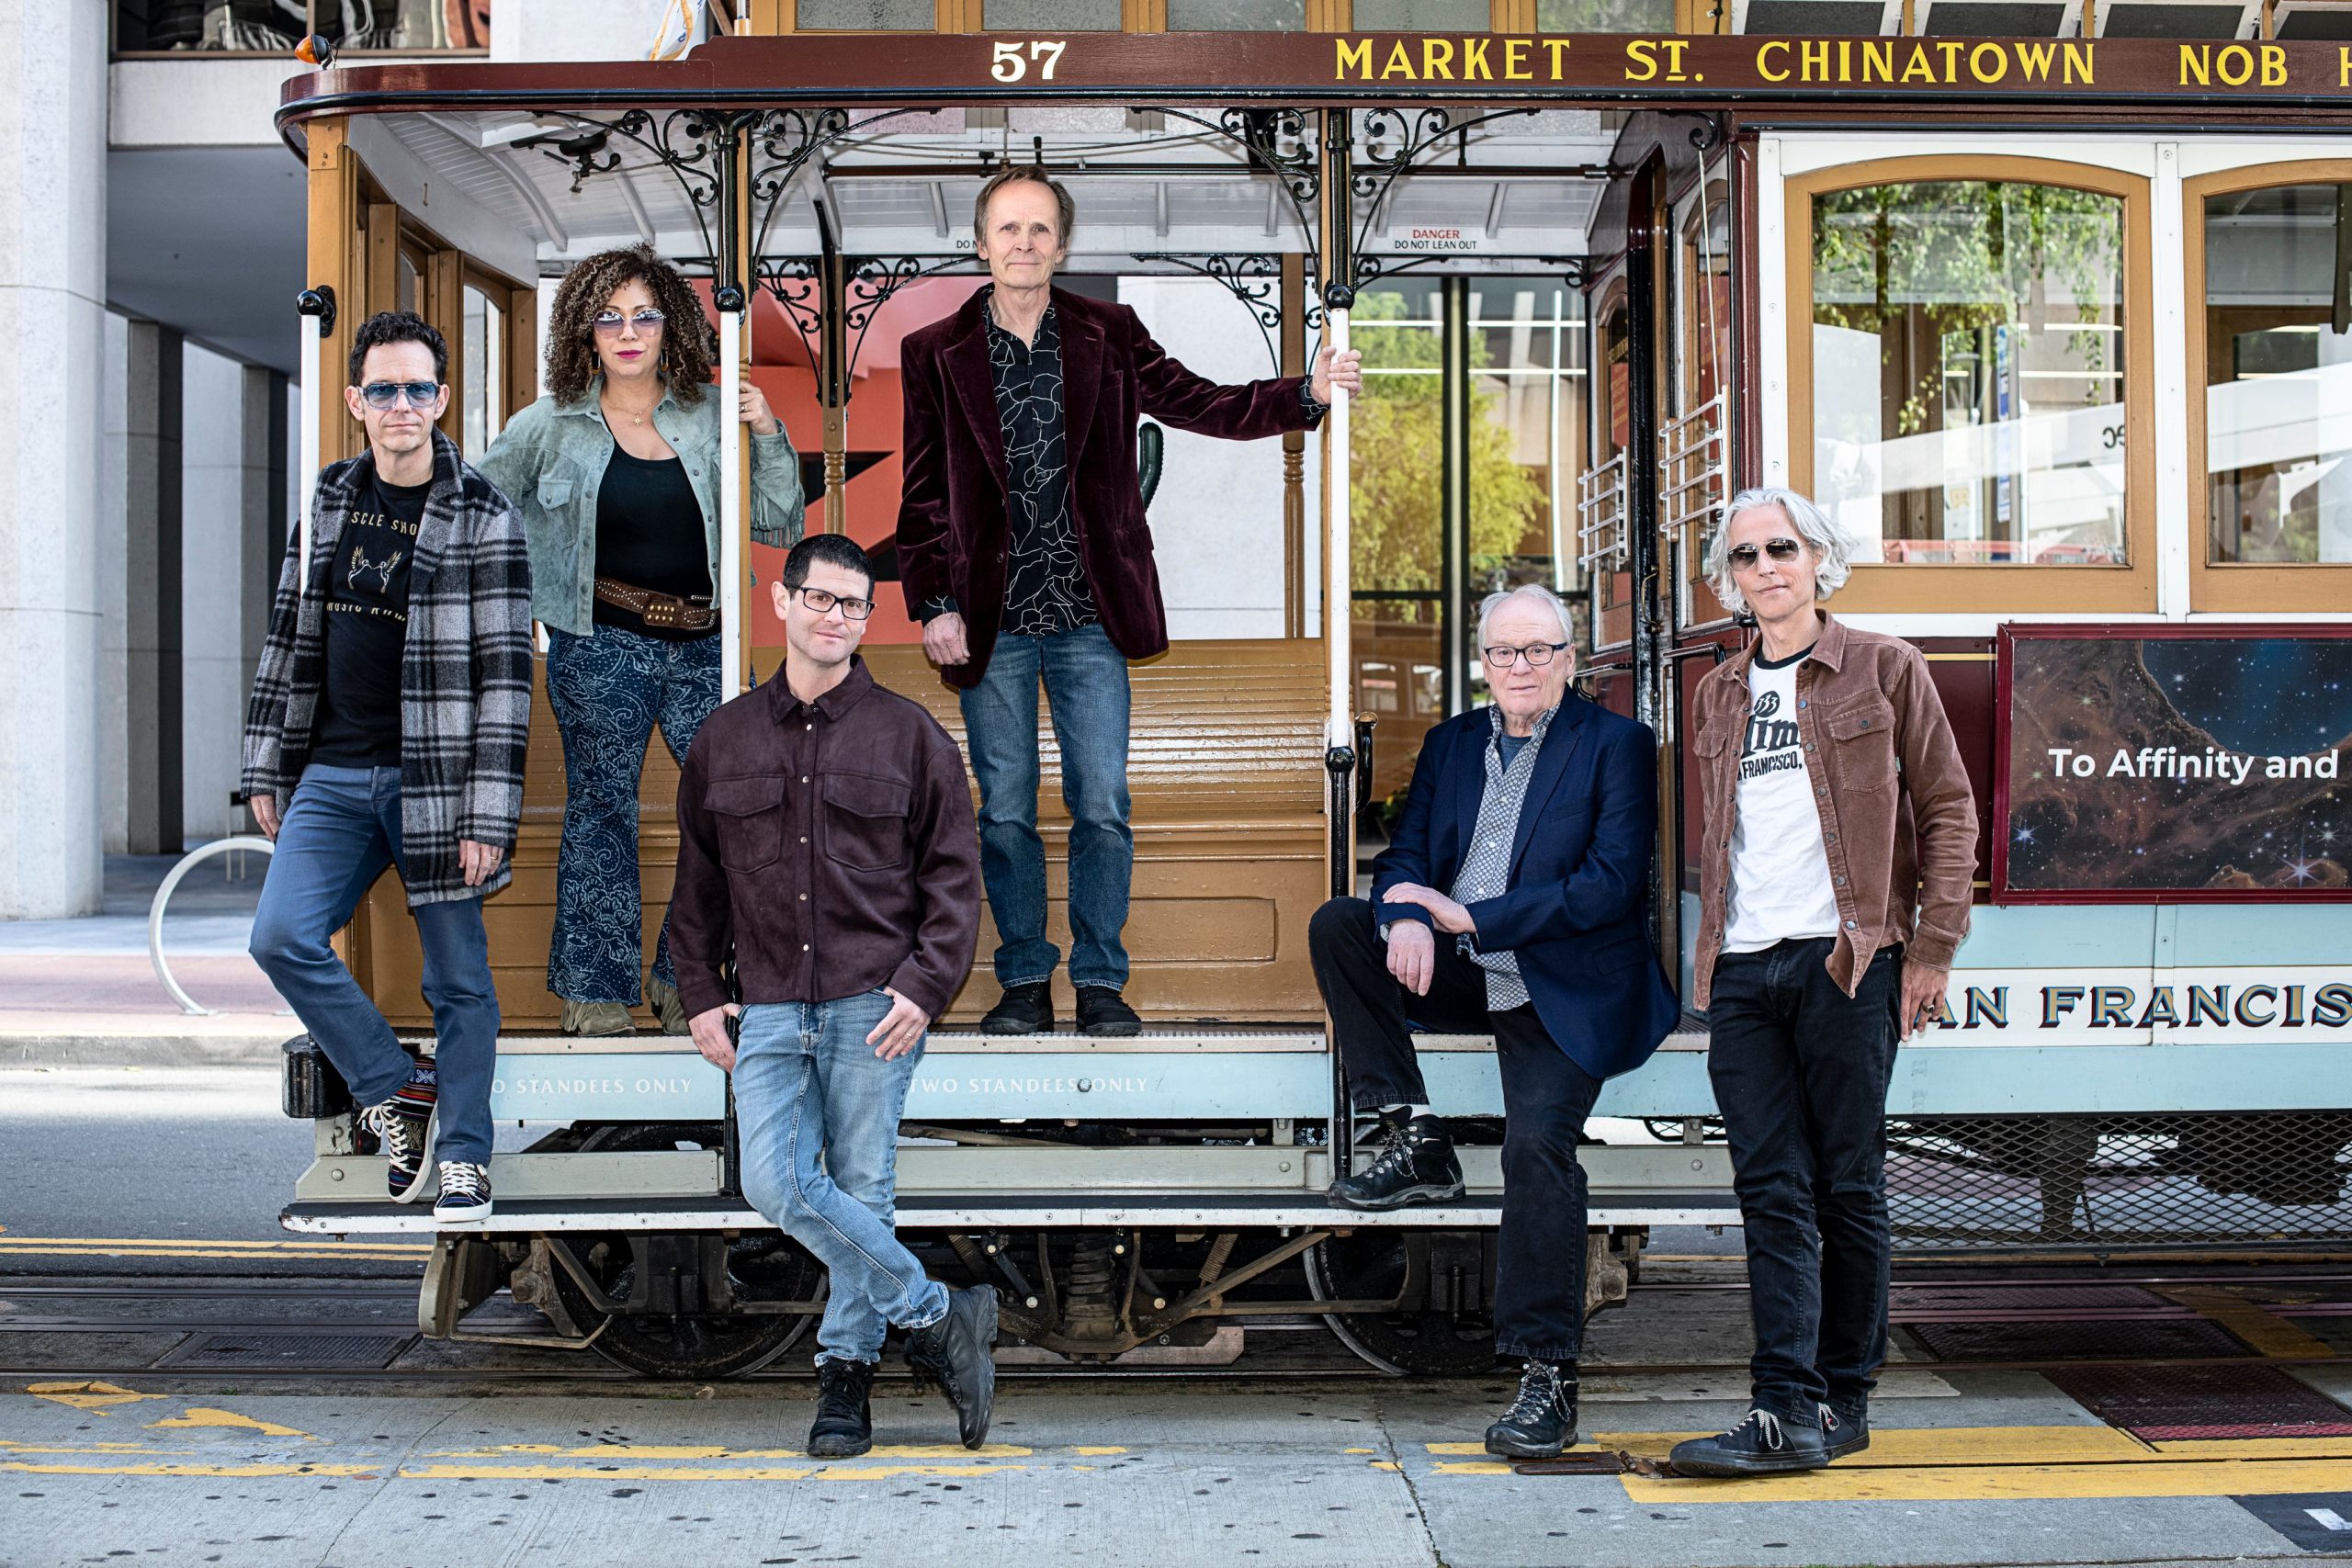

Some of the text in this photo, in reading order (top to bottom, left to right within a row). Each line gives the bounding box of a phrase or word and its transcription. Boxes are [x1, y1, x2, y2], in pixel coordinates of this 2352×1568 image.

[990, 40, 1067, 82] 57
[1335, 39, 1570, 81] MARKET
[1625, 39, 1704, 82] ST.
[1756, 40, 2096, 85] CHINATOWN
[2178, 44, 2289, 86] NOB
[1412, 230, 1460, 239] DANGER
[956, 240, 970, 249] DO
[1395, 240, 1477, 250] DO NOT LEAN OUT
[2048, 746, 2339, 786] To Affinity and
[2038, 982, 2352, 1030] FRANCIS
[515, 1078, 625, 1095] STANDEES
[635, 1078, 693, 1094] ONLY
[910, 1077, 1148, 1093] TWO STANDEES ONLY
